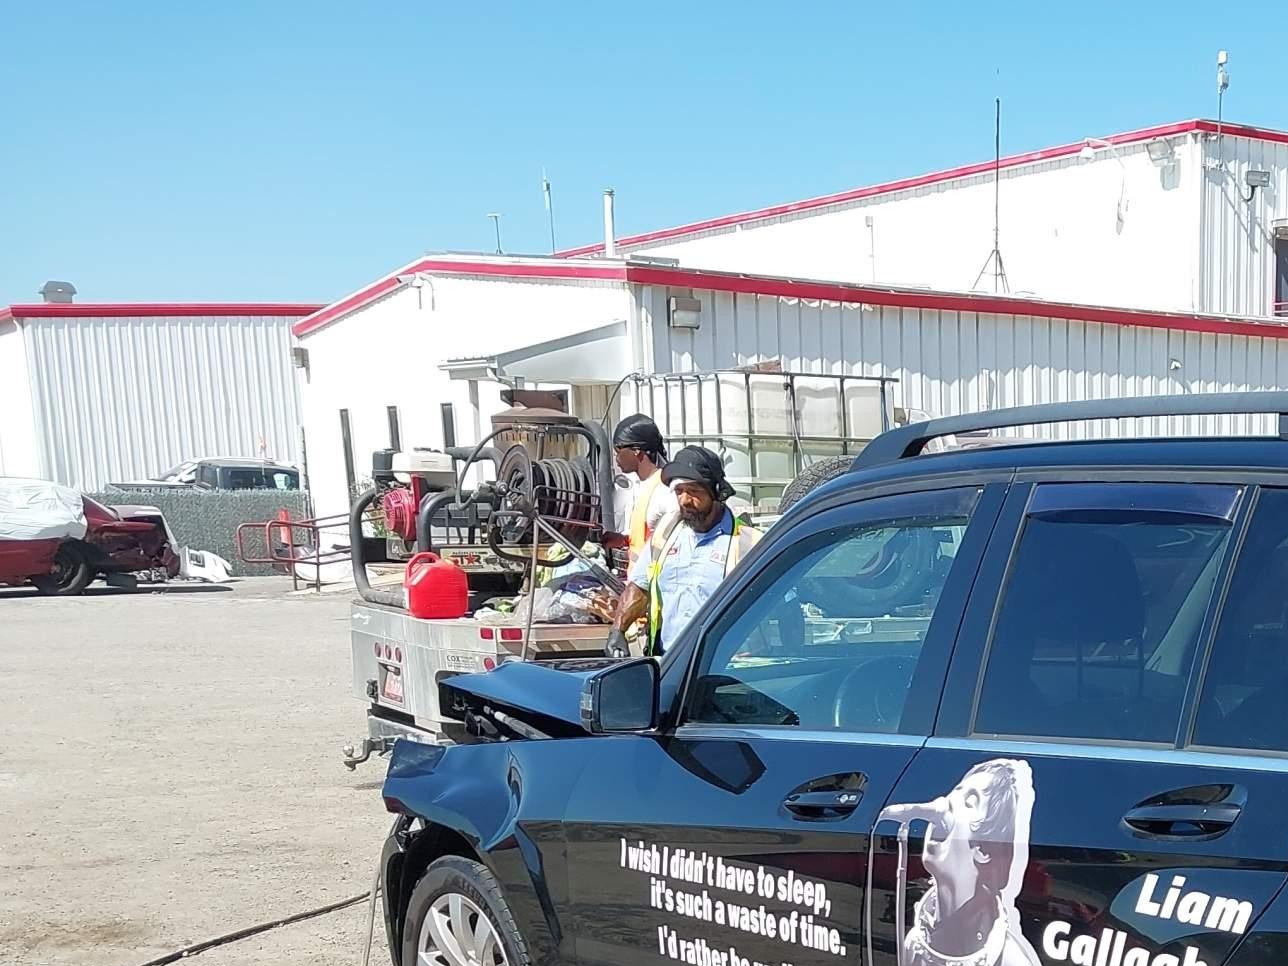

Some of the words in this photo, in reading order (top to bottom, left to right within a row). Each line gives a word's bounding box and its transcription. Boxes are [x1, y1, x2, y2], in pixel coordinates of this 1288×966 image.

[620, 838, 626, 867] I
[628, 841, 660, 874] wish
[662, 846, 669, 876] I
[670, 848, 714, 886] didn't
[716, 856, 754, 894] have
[757, 865, 775, 898] to
[777, 870, 831, 917] sleep,
[1135, 873, 1253, 934] Liam
[650, 877, 674, 912] it's
[676, 890, 712, 921] such
[715, 900, 725, 925] a
[727, 905, 776, 938] waste
[779, 910, 798, 943] of
[800, 915, 847, 956] time.
[658, 925, 678, 959] I'd
